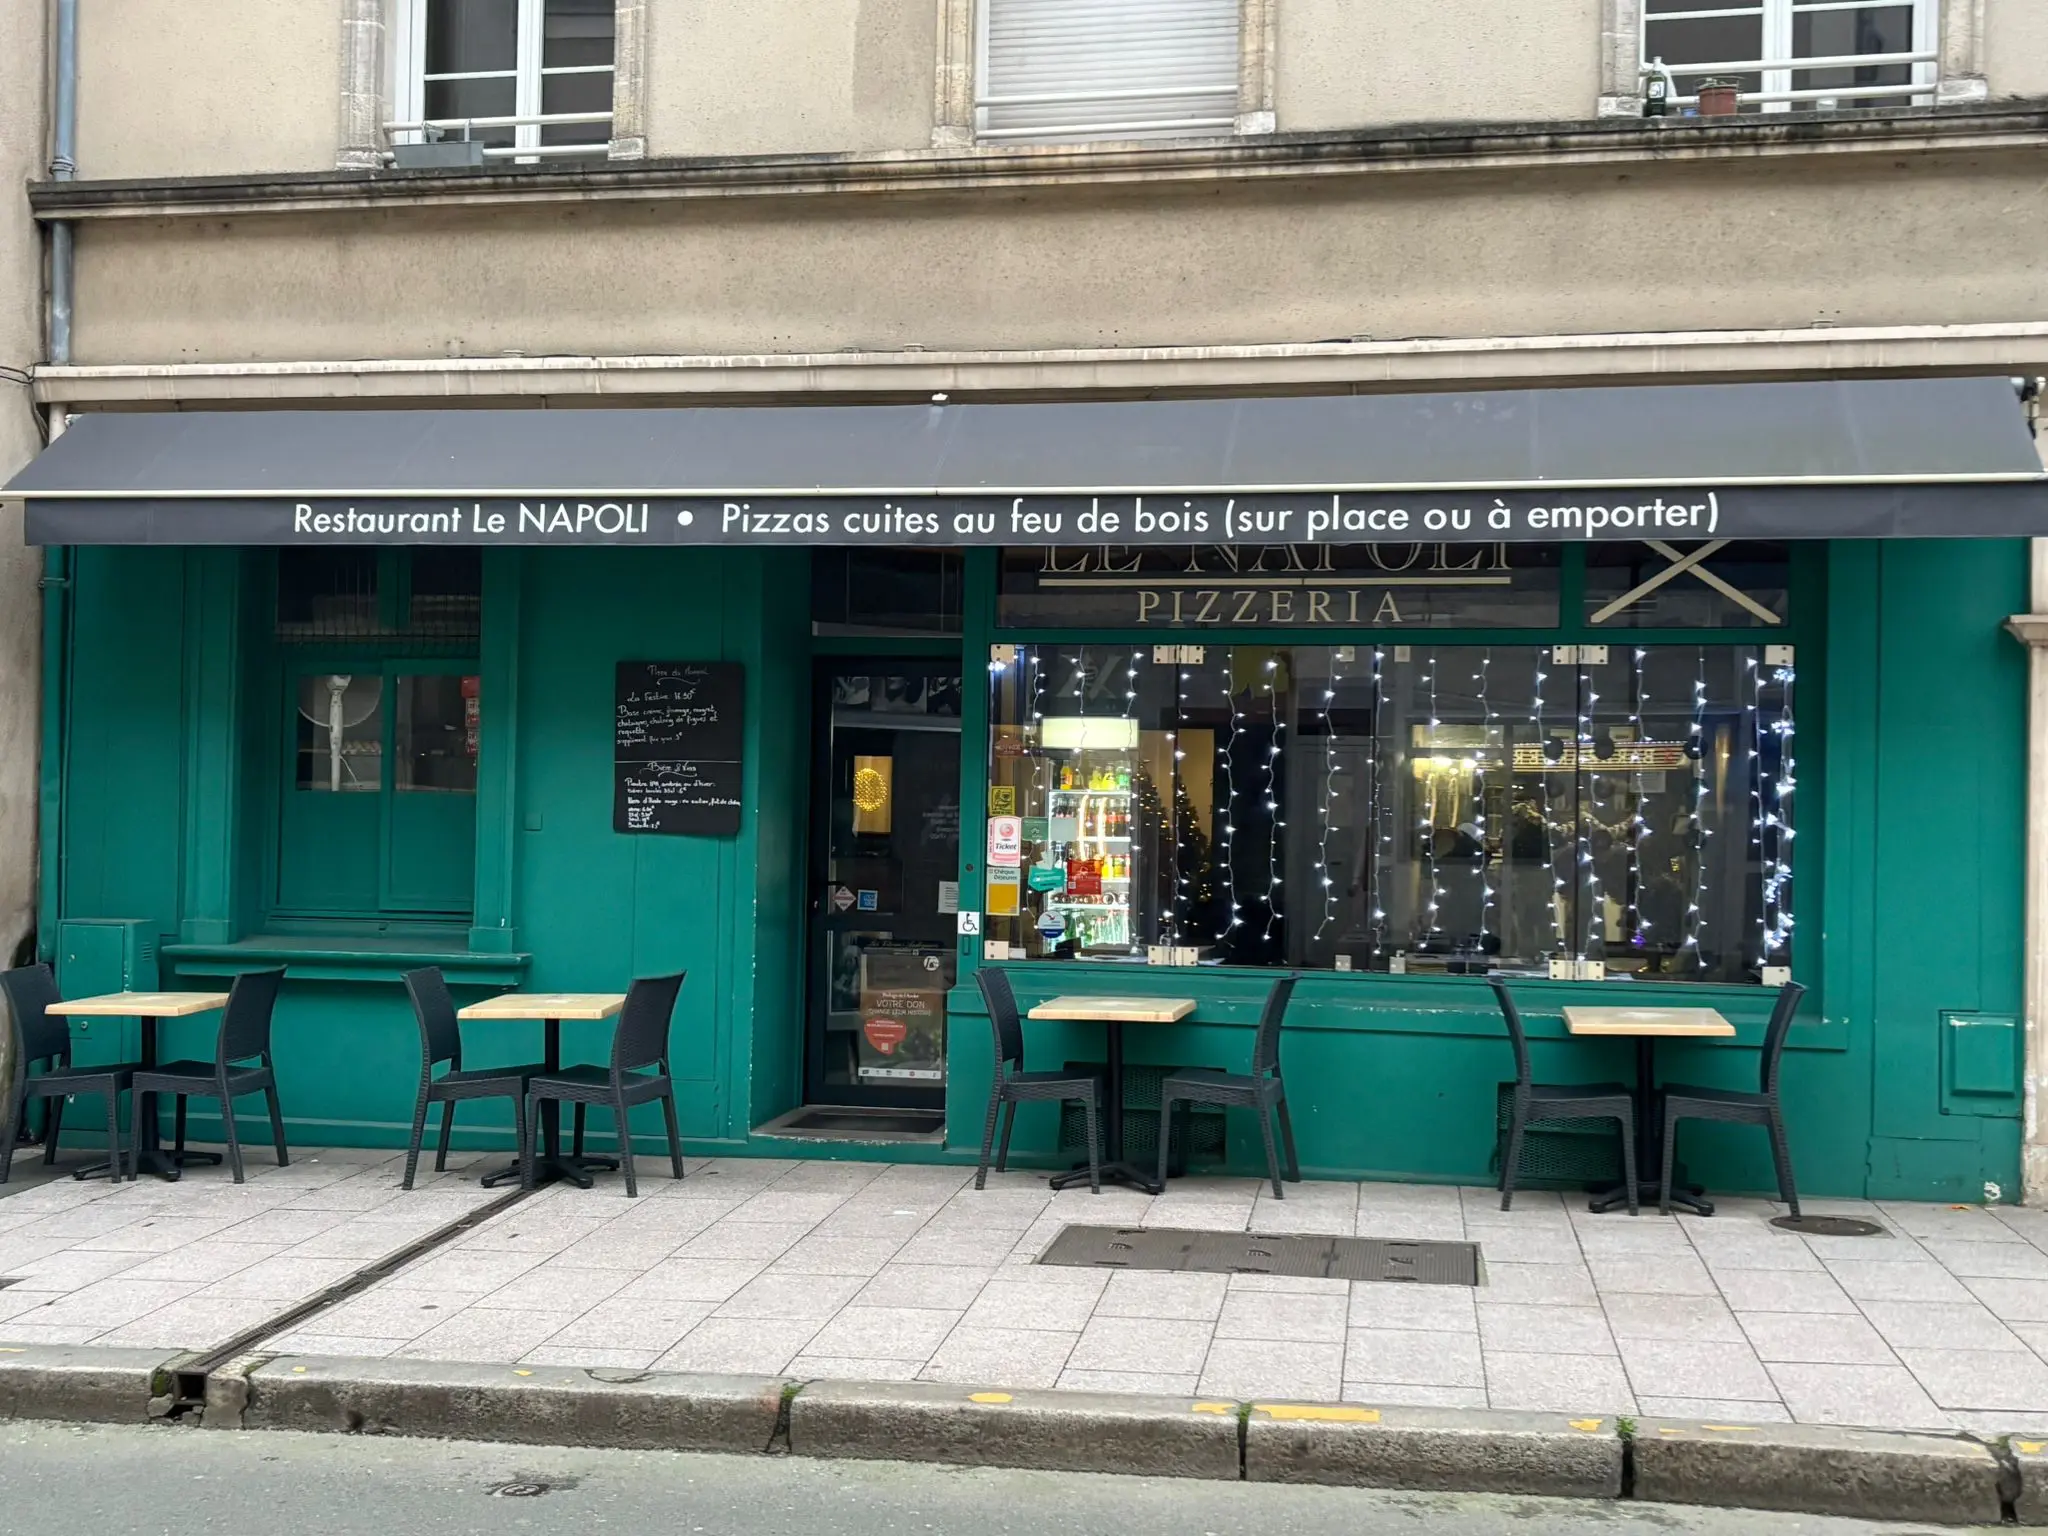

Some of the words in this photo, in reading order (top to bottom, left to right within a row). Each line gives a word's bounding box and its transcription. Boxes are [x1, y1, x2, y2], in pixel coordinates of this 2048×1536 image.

[294, 503, 462, 534] Restaurant
[472, 503, 506, 534] Le
[518, 503, 648, 534] NAPOLI
[722, 503, 830, 534] Pizzas
[843, 503, 940, 534] cuites
[953, 513, 995, 534] au
[1010, 498, 1062, 534] feu
[1077, 498, 1120, 534] de
[1134, 497, 1209, 533] bois
[1225, 499, 1293, 539] (sur
[1307, 494, 1409, 541] place
[1423, 509, 1471, 531] ou
[1487, 498, 1511, 530] à
[1527, 492, 1718, 538] emporter)
[1135, 589, 1403, 623] PIZZERIA
[876, 999, 904, 1008] VOTRE
[906, 1000, 926, 1009] DON
